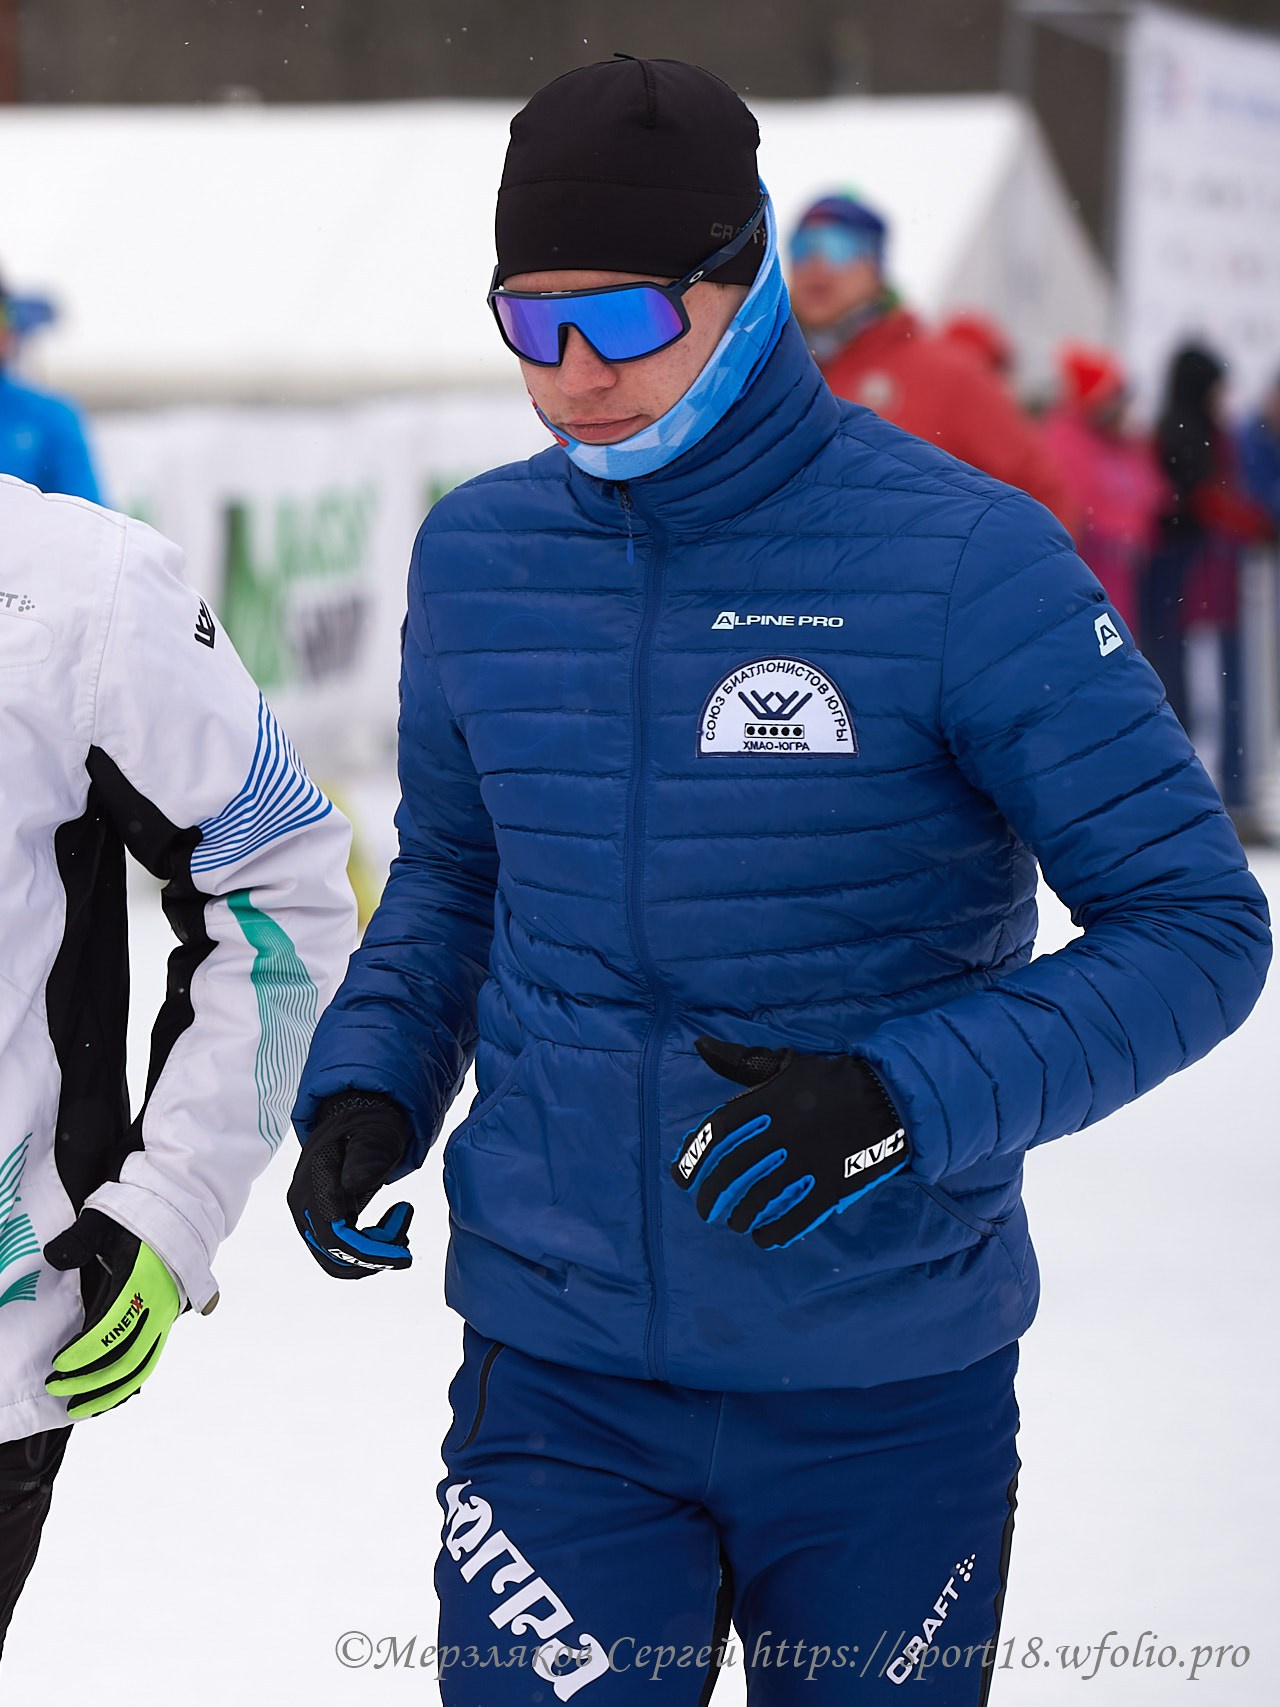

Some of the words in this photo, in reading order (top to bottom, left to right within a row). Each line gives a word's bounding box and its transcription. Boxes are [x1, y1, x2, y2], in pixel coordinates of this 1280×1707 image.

[711, 611, 795, 630] ALPINE
[798, 616, 844, 628] PRO
[705, 696, 726, 741] СОЮЗ
[722, 662, 829, 695] БИАТЛОНИСТОВ
[824, 695, 849, 742] ЮГРЫ
[743, 740, 810, 751] ХМАО-ЮГРА
[886, 1577, 959, 1685] CRAFT
